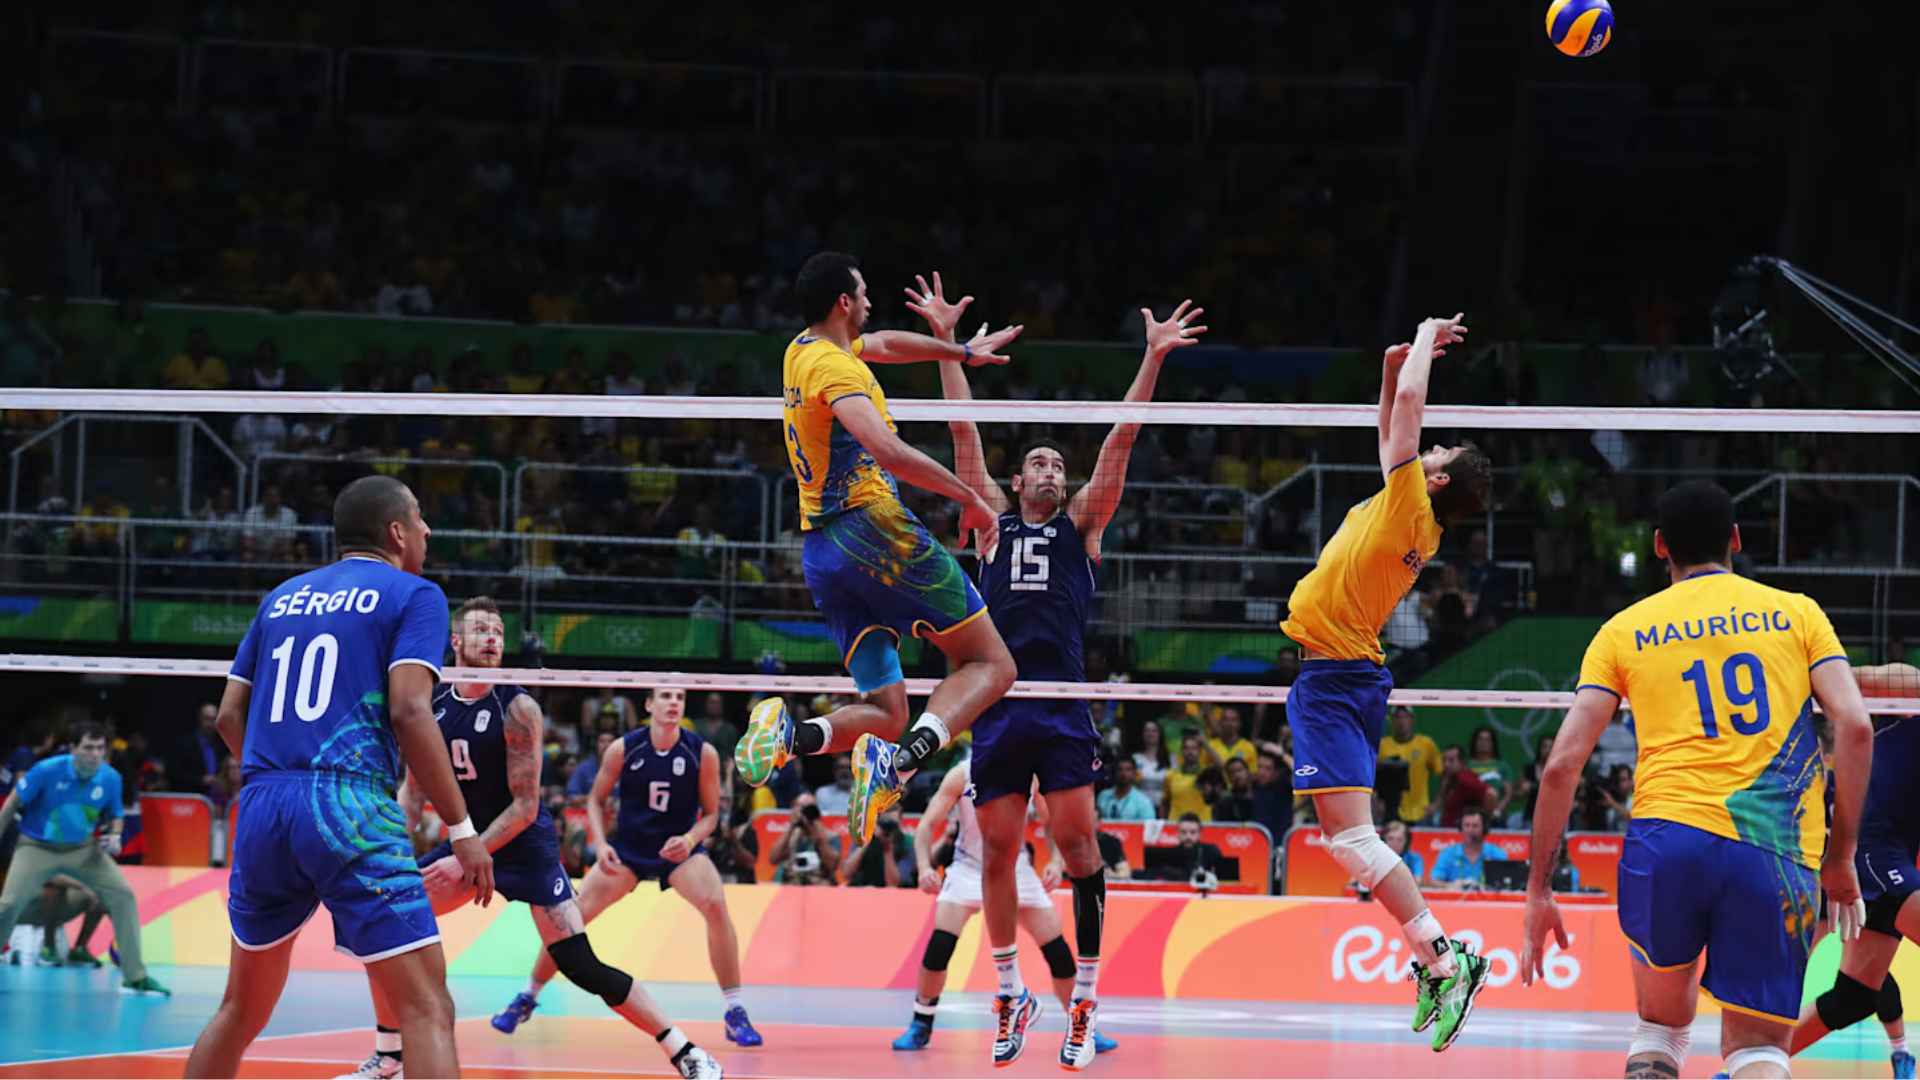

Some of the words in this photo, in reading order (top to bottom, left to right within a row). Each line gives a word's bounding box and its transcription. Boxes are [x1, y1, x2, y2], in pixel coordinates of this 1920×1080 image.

[789, 424, 812, 482] 3
[1010, 537, 1050, 582] 15
[268, 585, 380, 618] SÉRGIO
[1635, 607, 1791, 651] MAURÍCIO
[270, 633, 339, 723] 10
[1681, 652, 1771, 737] 19
[451, 738, 478, 780] 9
[648, 781, 670, 812] 6
[1887, 869, 1905, 885] 5
[1331, 925, 1581, 990] Ri06
